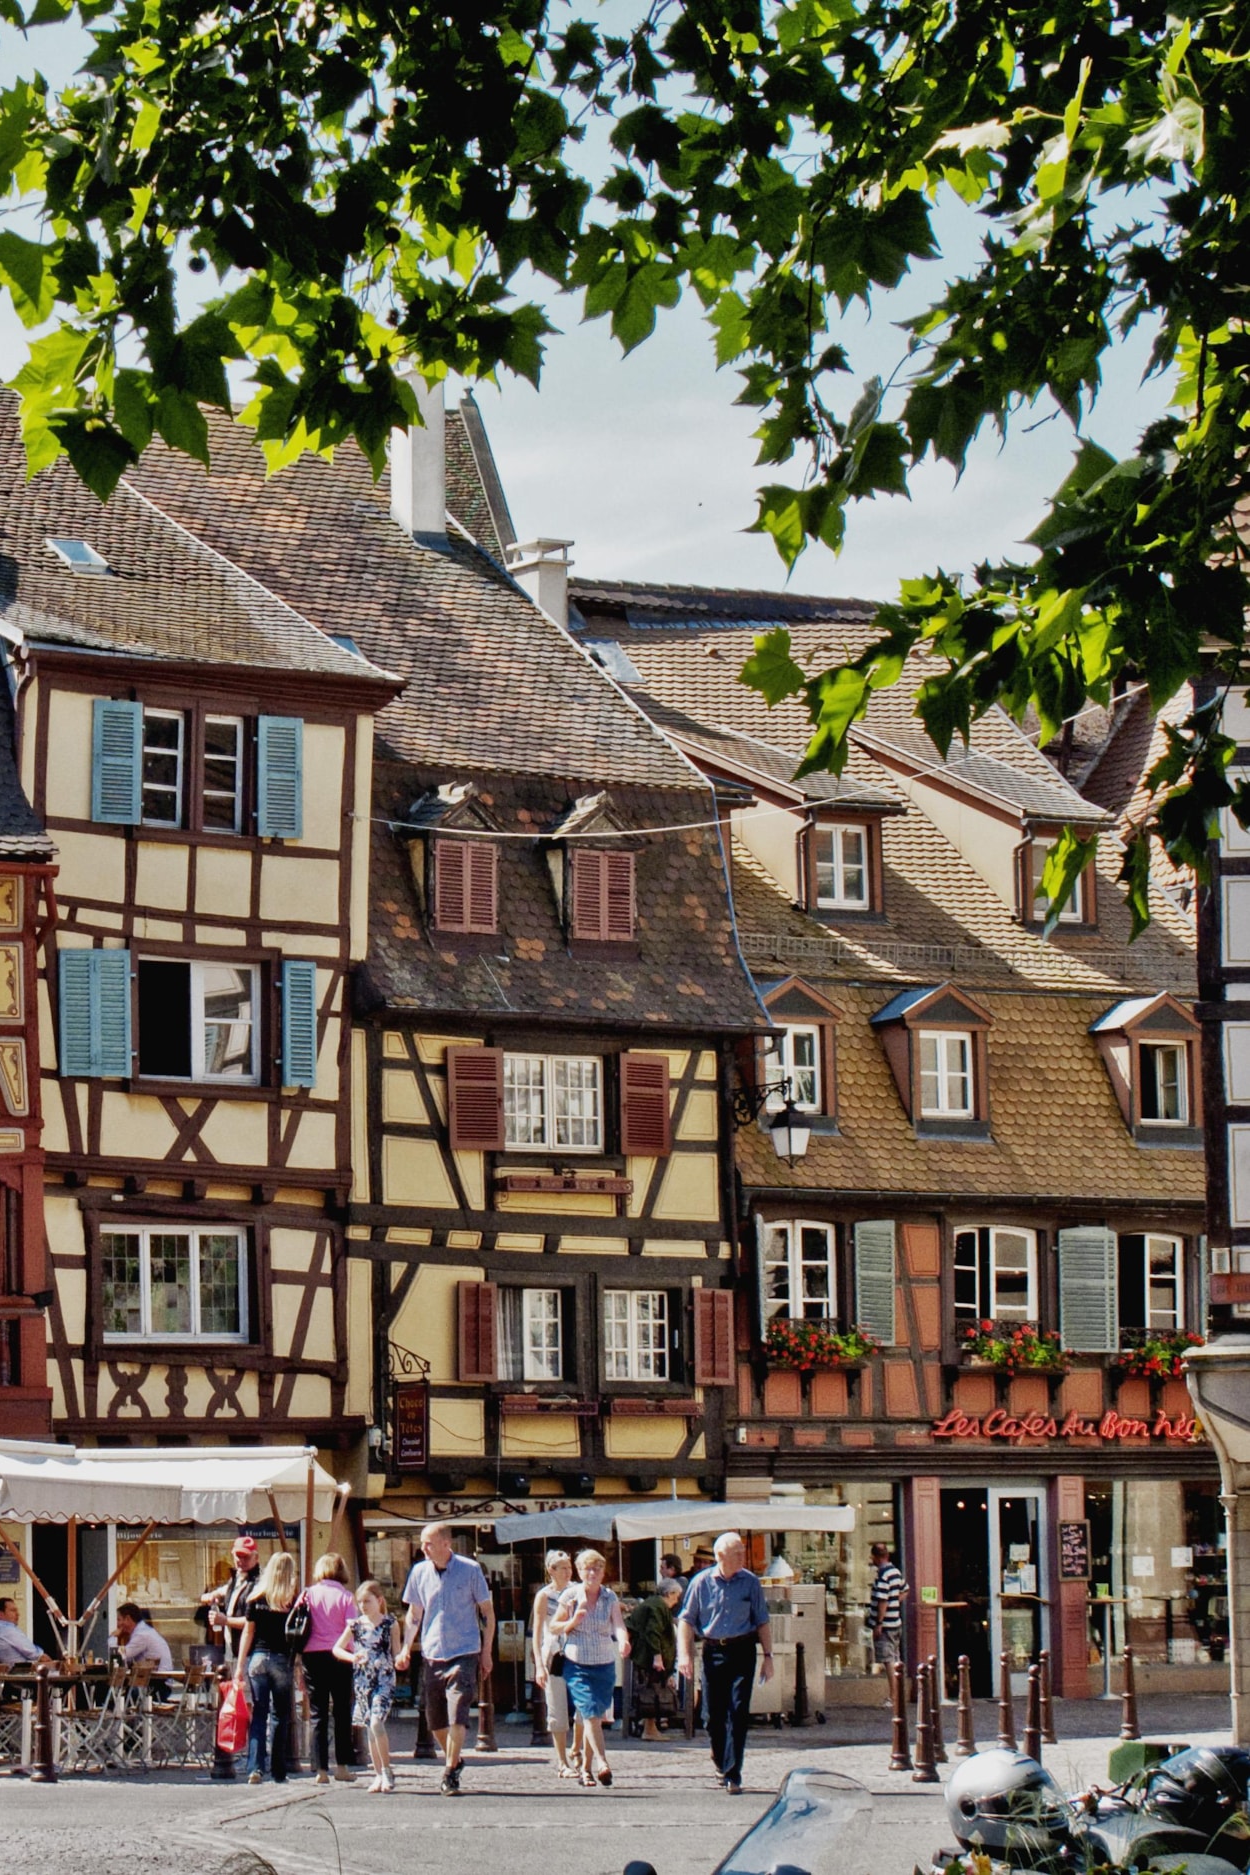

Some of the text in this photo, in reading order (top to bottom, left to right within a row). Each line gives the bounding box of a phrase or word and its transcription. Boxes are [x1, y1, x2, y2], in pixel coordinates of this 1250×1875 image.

[933, 1409, 980, 1437] Les
[1060, 1409, 1097, 1436] Au
[1100, 1409, 1150, 1439] Bon
